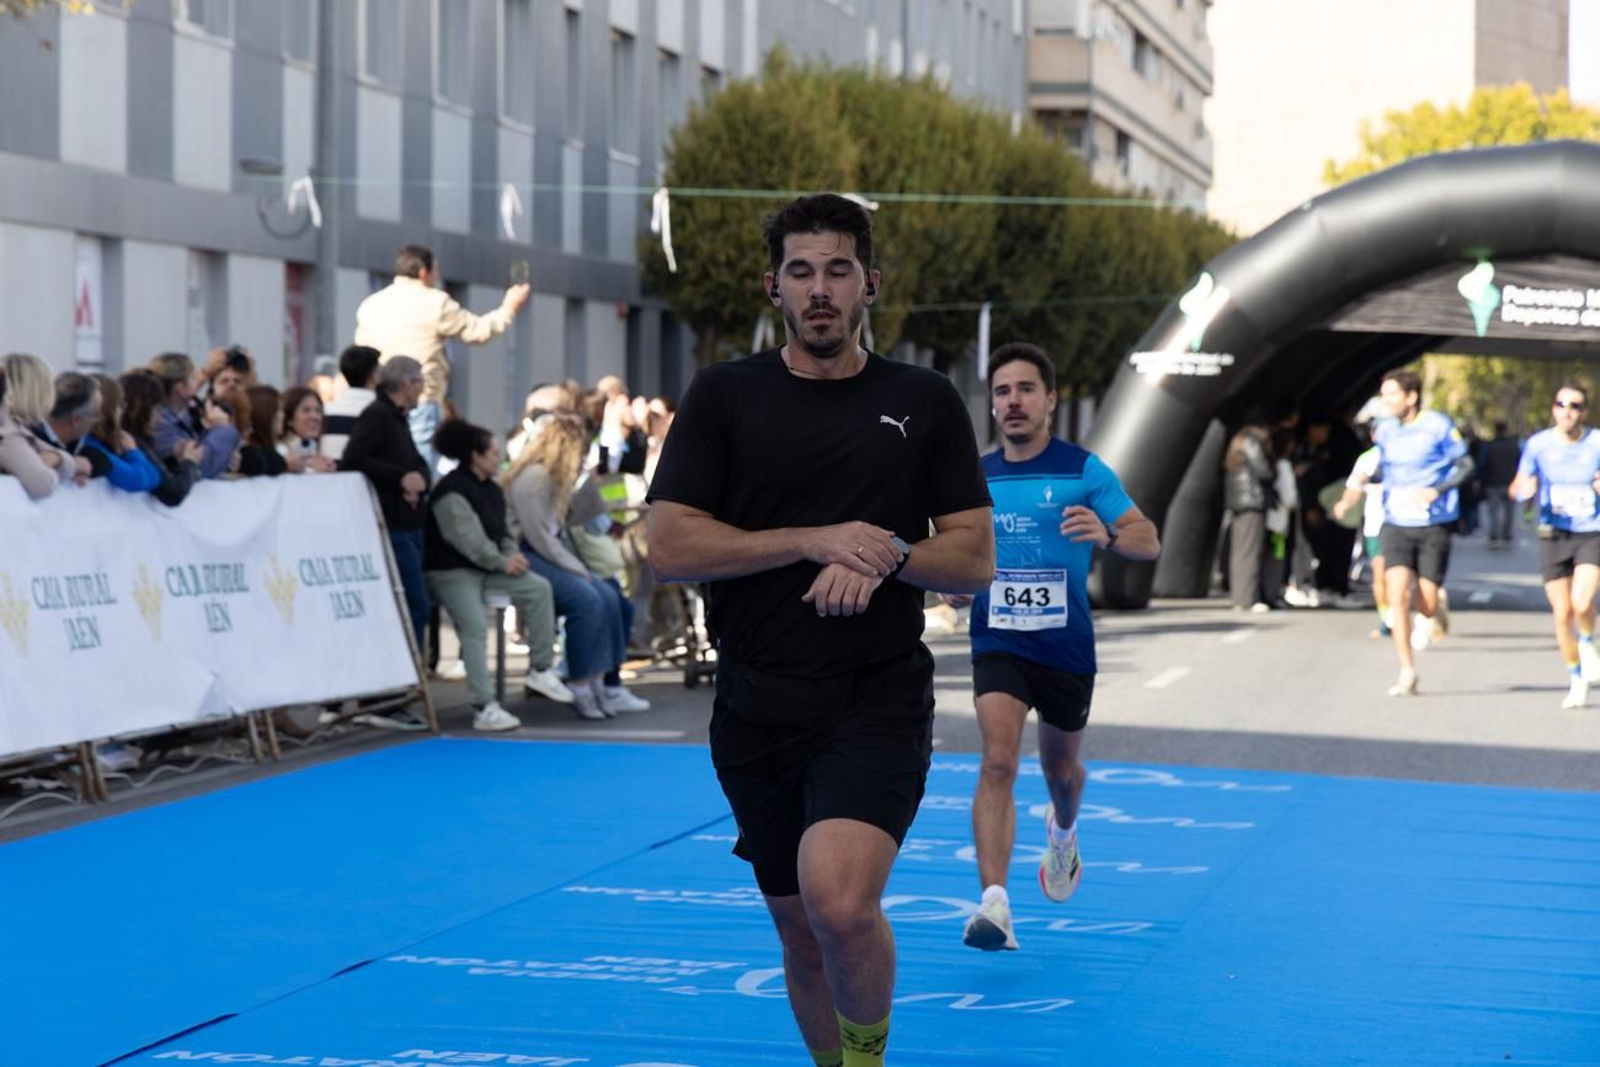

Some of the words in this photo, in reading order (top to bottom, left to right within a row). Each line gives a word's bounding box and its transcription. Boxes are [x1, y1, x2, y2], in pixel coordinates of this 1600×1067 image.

[202, 562, 250, 595] RURAL
[331, 552, 381, 584] RURAL
[64, 572, 118, 608] RURAL
[1004, 587, 1050, 607] 643
